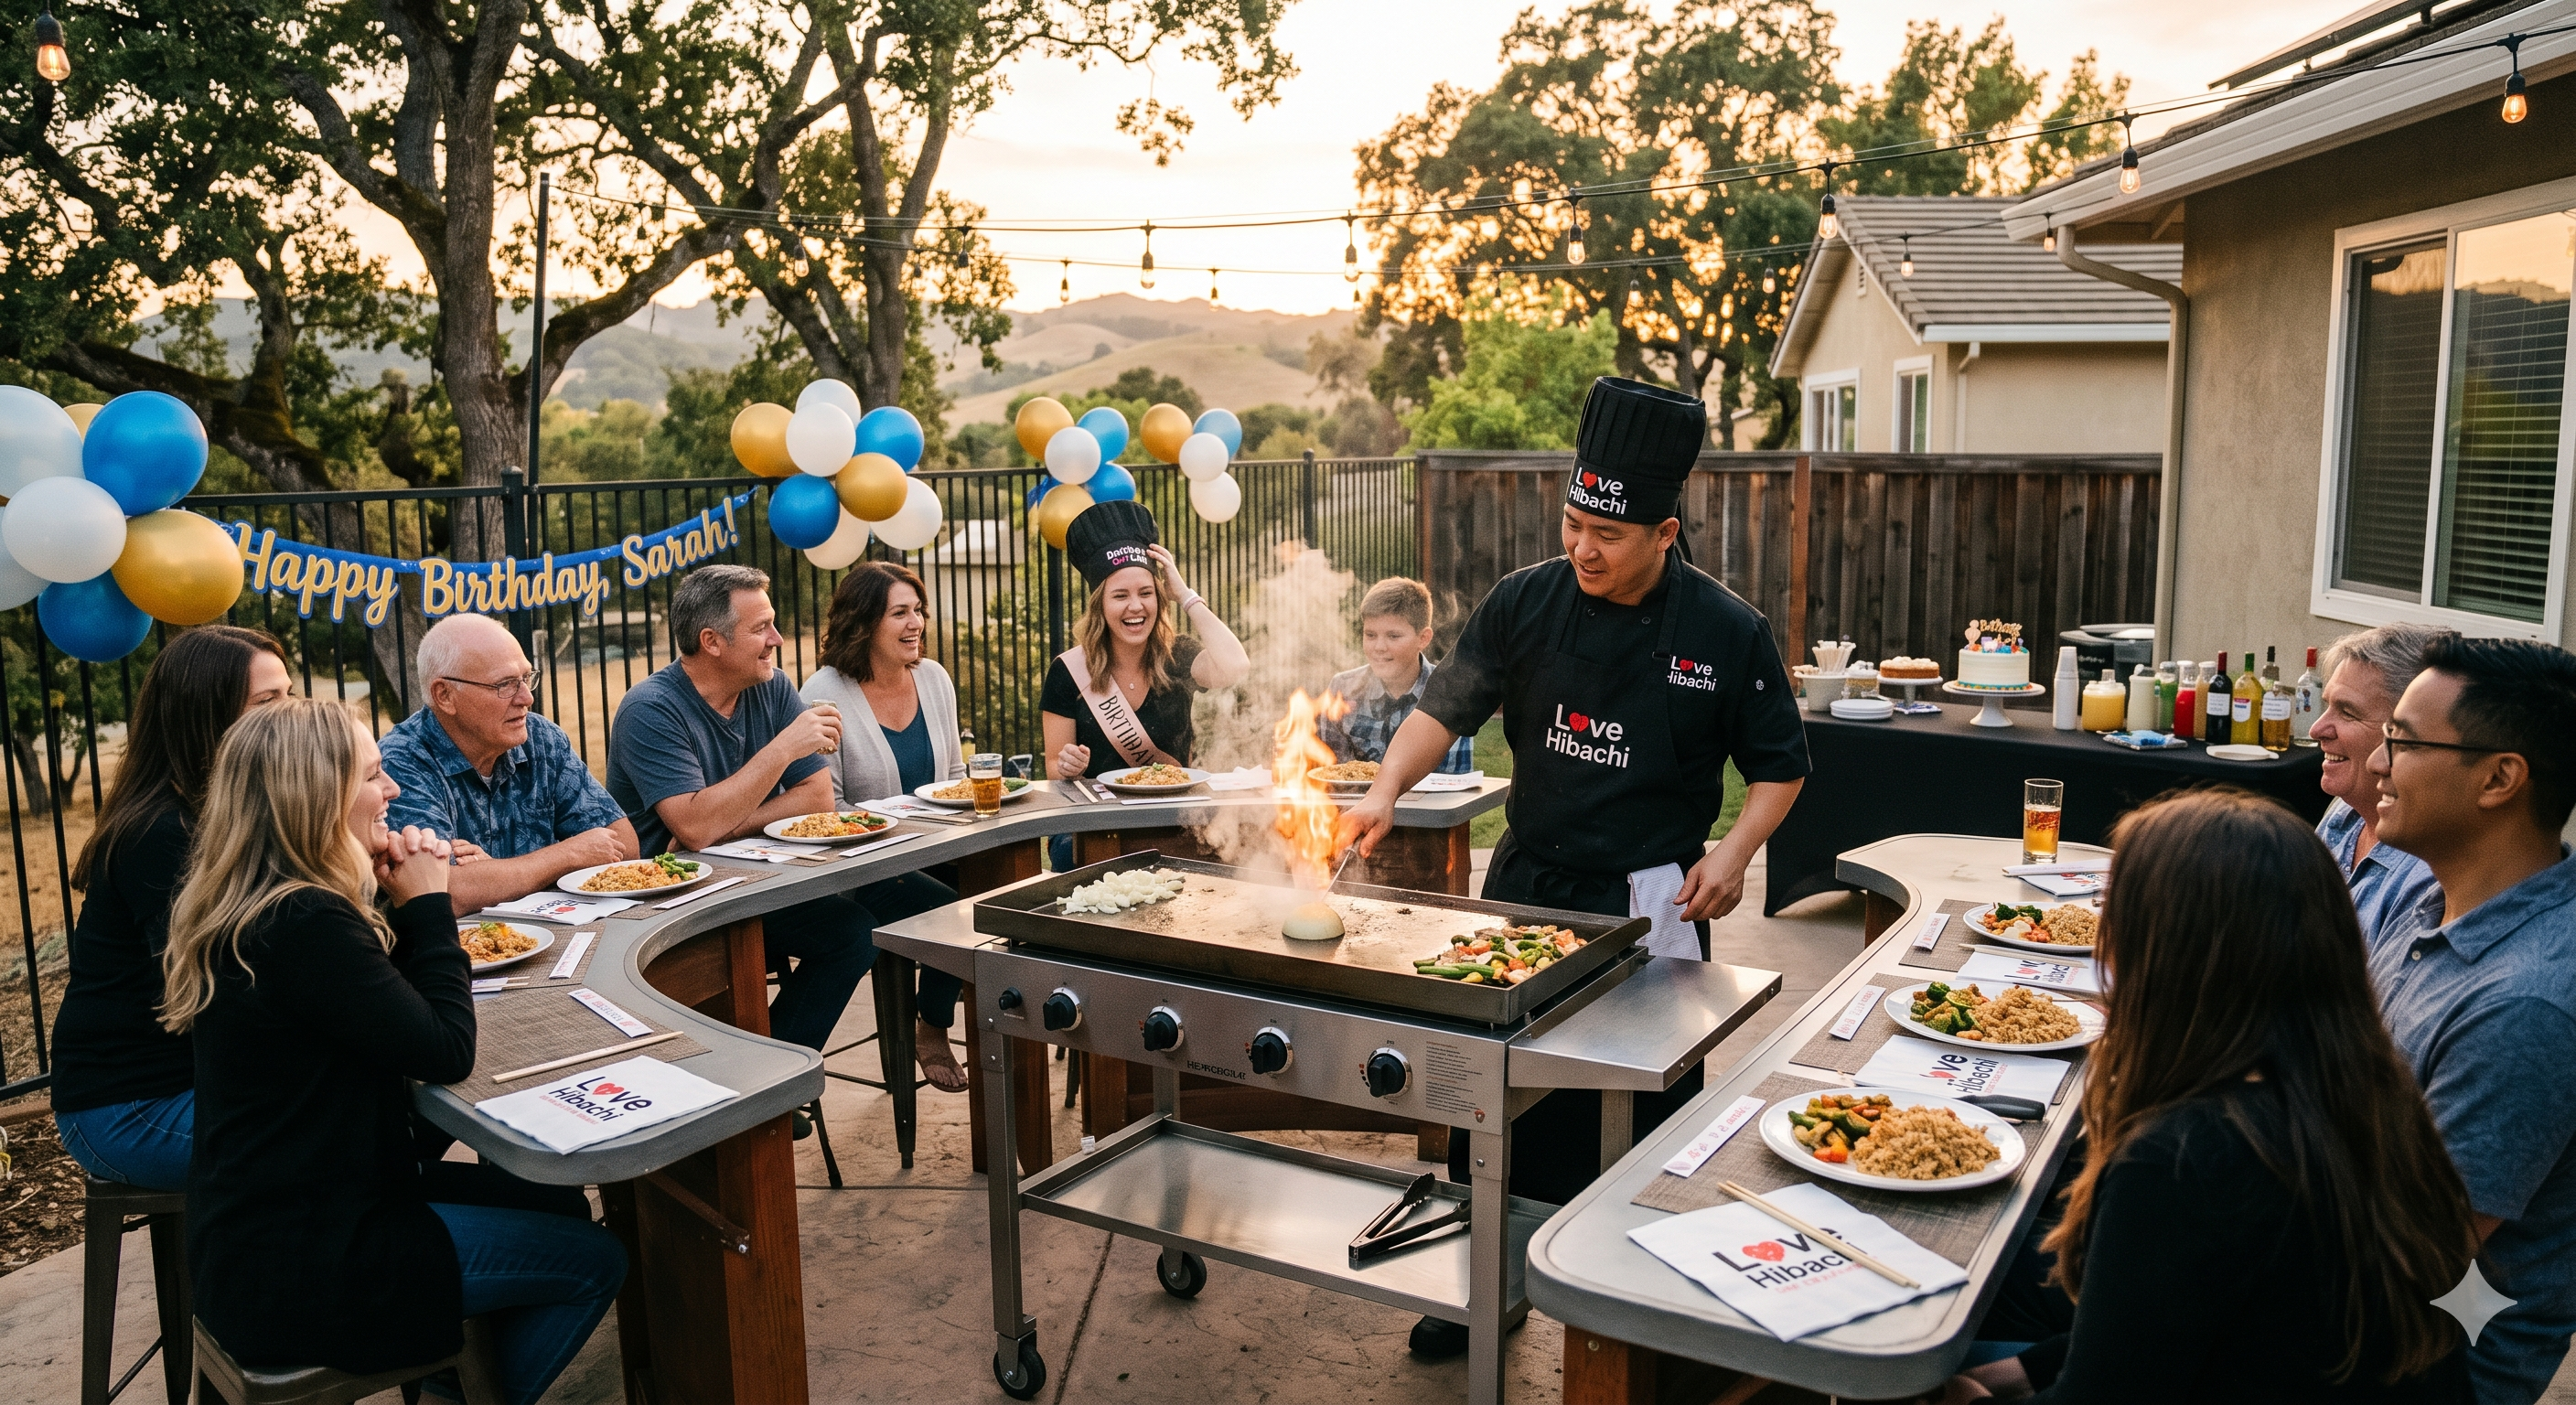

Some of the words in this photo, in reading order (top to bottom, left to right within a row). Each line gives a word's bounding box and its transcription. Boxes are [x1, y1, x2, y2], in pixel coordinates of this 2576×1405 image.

[235, 521, 399, 627] Happy
[418, 552, 610, 617] Birthday,
[622, 497, 739, 587] Sarah!
[1545, 727, 1630, 768] Hibachi
[548, 1087, 624, 1121] Hibachi
